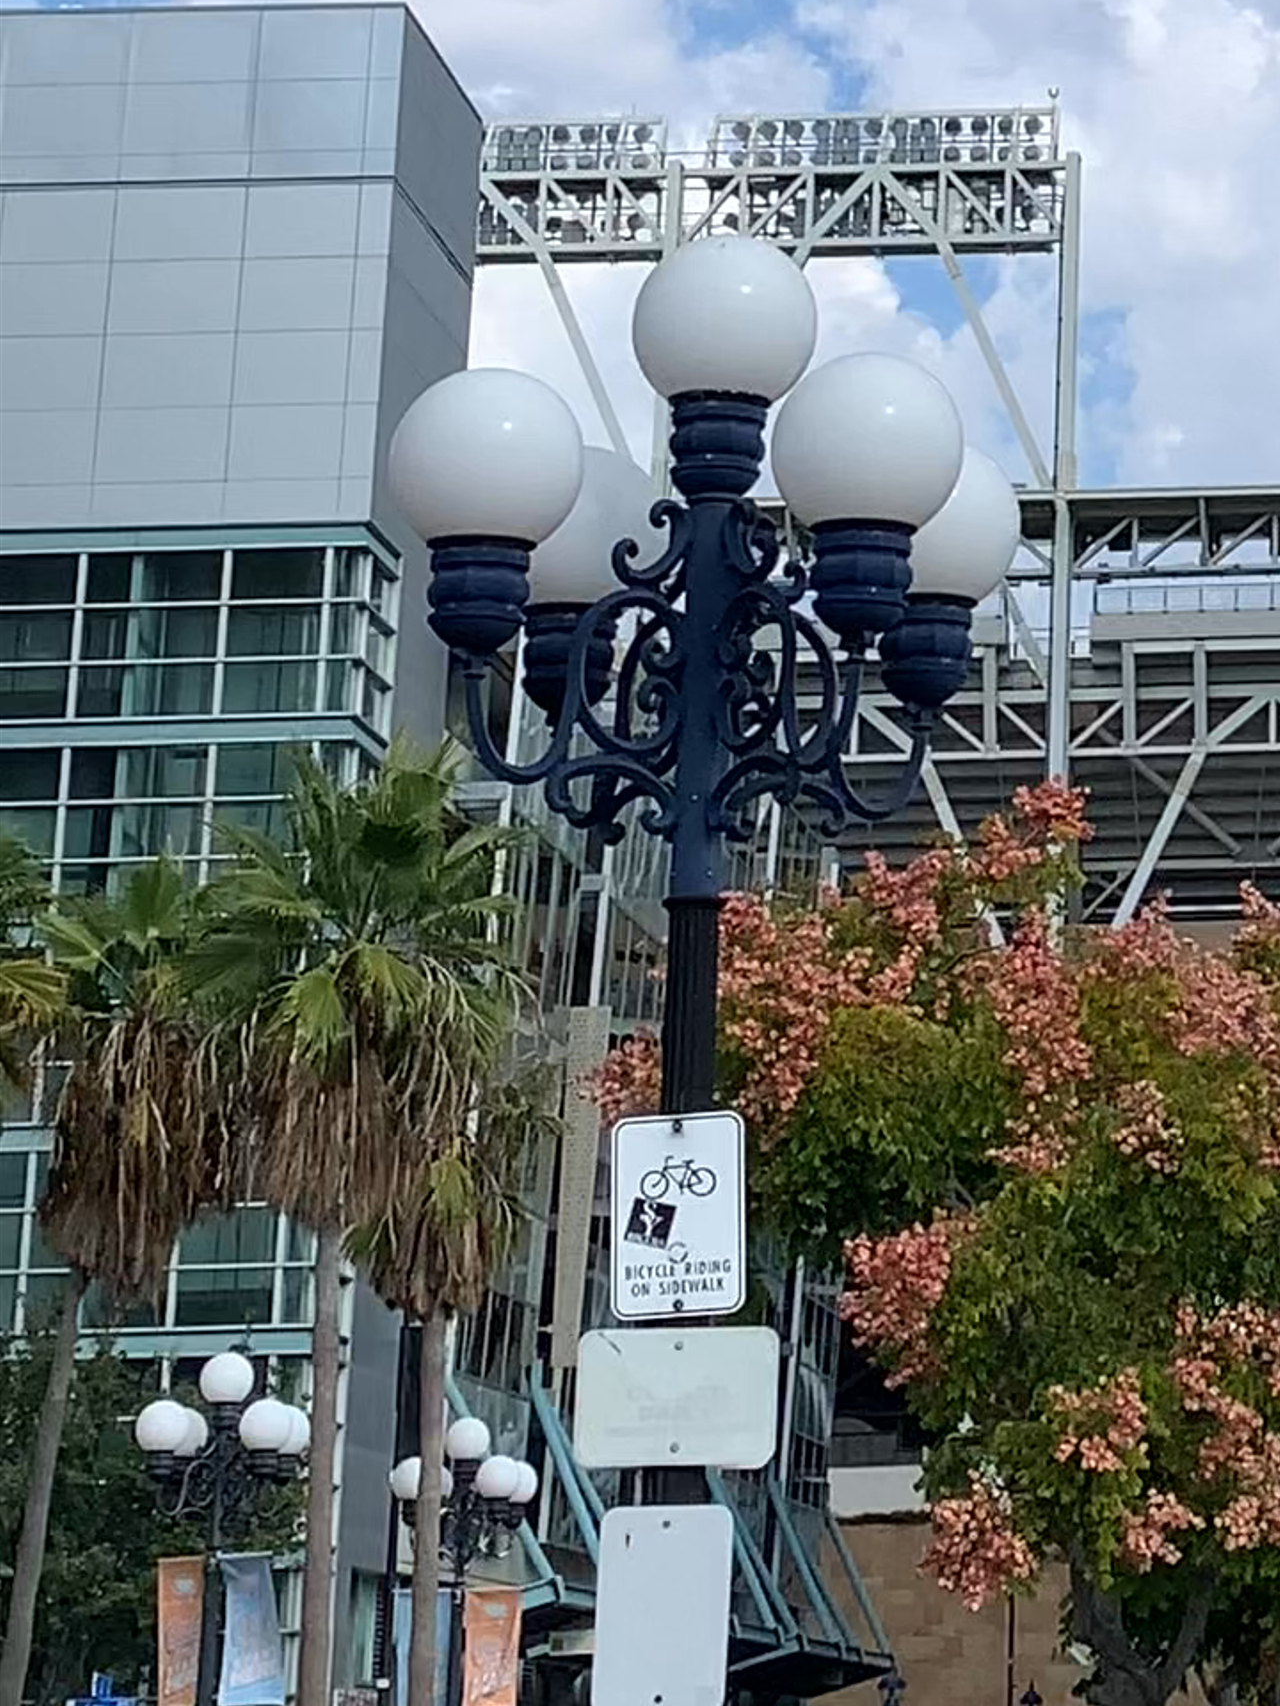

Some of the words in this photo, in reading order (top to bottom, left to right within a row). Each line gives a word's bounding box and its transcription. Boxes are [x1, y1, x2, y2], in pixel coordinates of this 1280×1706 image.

[624, 1263, 676, 1281] BICYCLE
[685, 1258, 732, 1275] RIDING
[630, 1282, 650, 1298] ON
[658, 1278, 725, 1296] SIDEWALK
